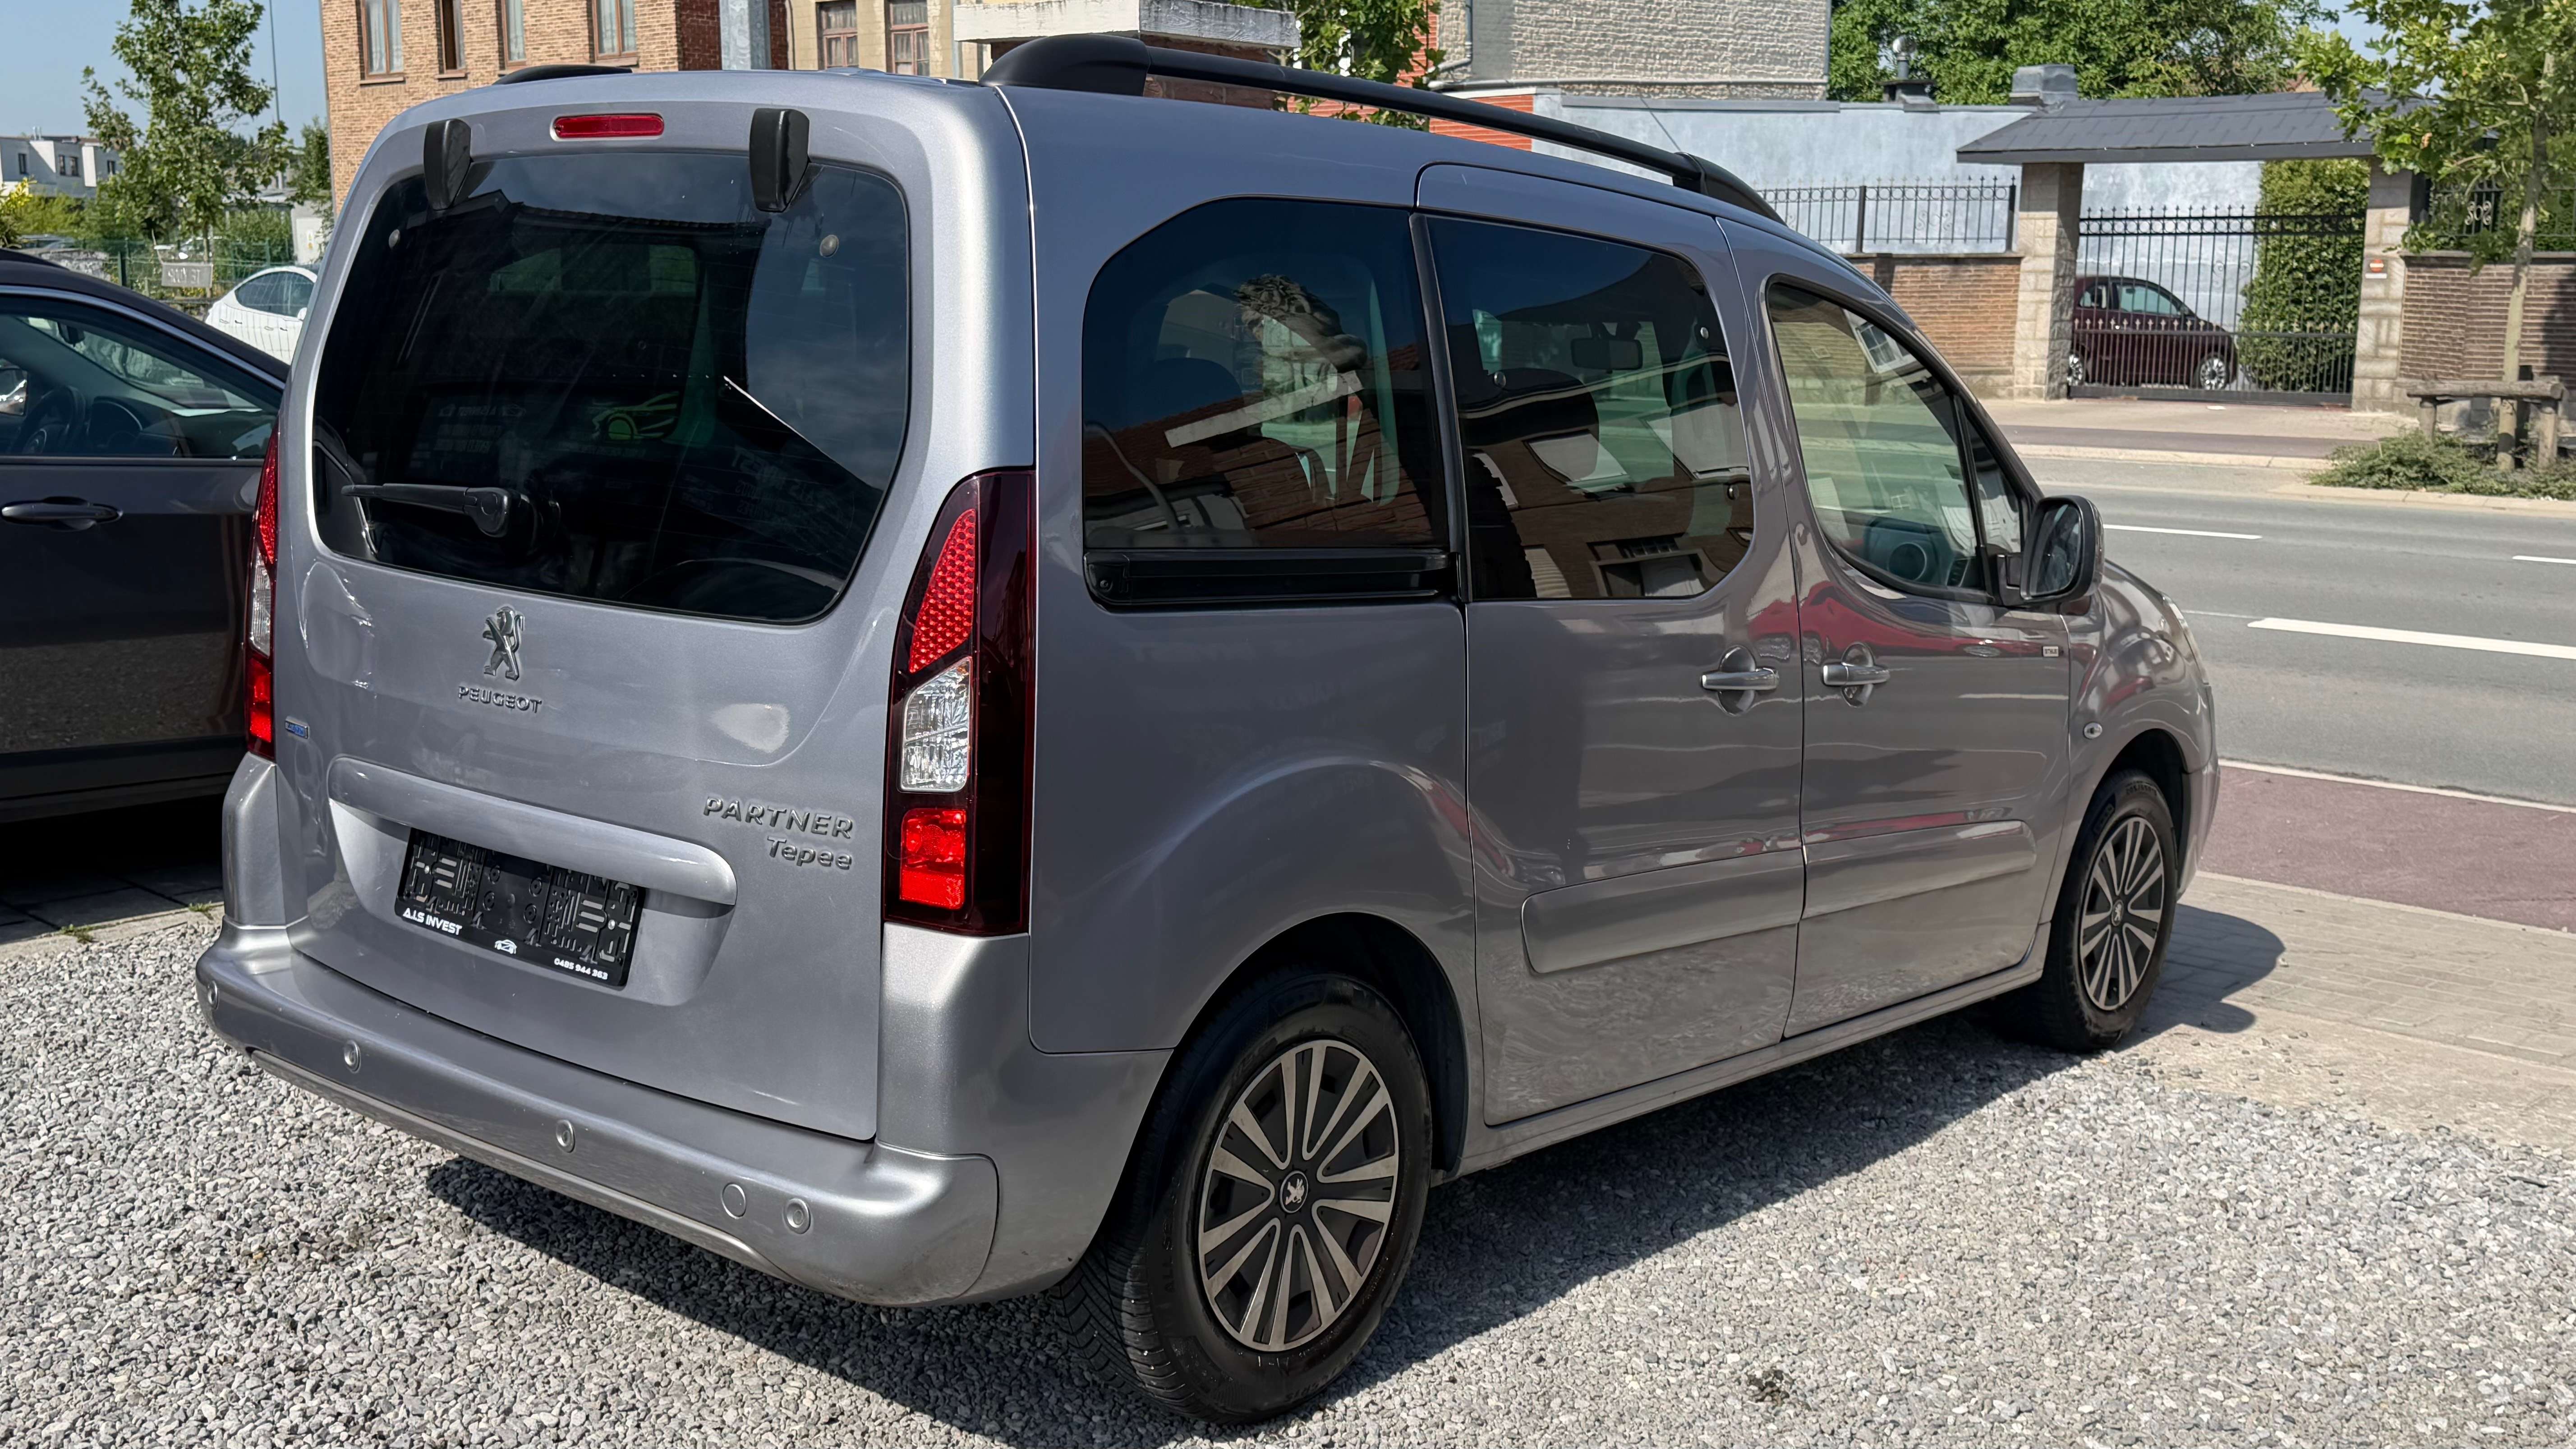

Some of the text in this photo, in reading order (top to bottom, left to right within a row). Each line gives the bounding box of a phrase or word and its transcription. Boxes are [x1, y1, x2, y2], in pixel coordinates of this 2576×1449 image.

[458, 685, 543, 713] PEUGEOT
[703, 796, 853, 839] PARTNER
[767, 836, 852, 870] Tepee
[425, 915, 462, 935] INVEST
